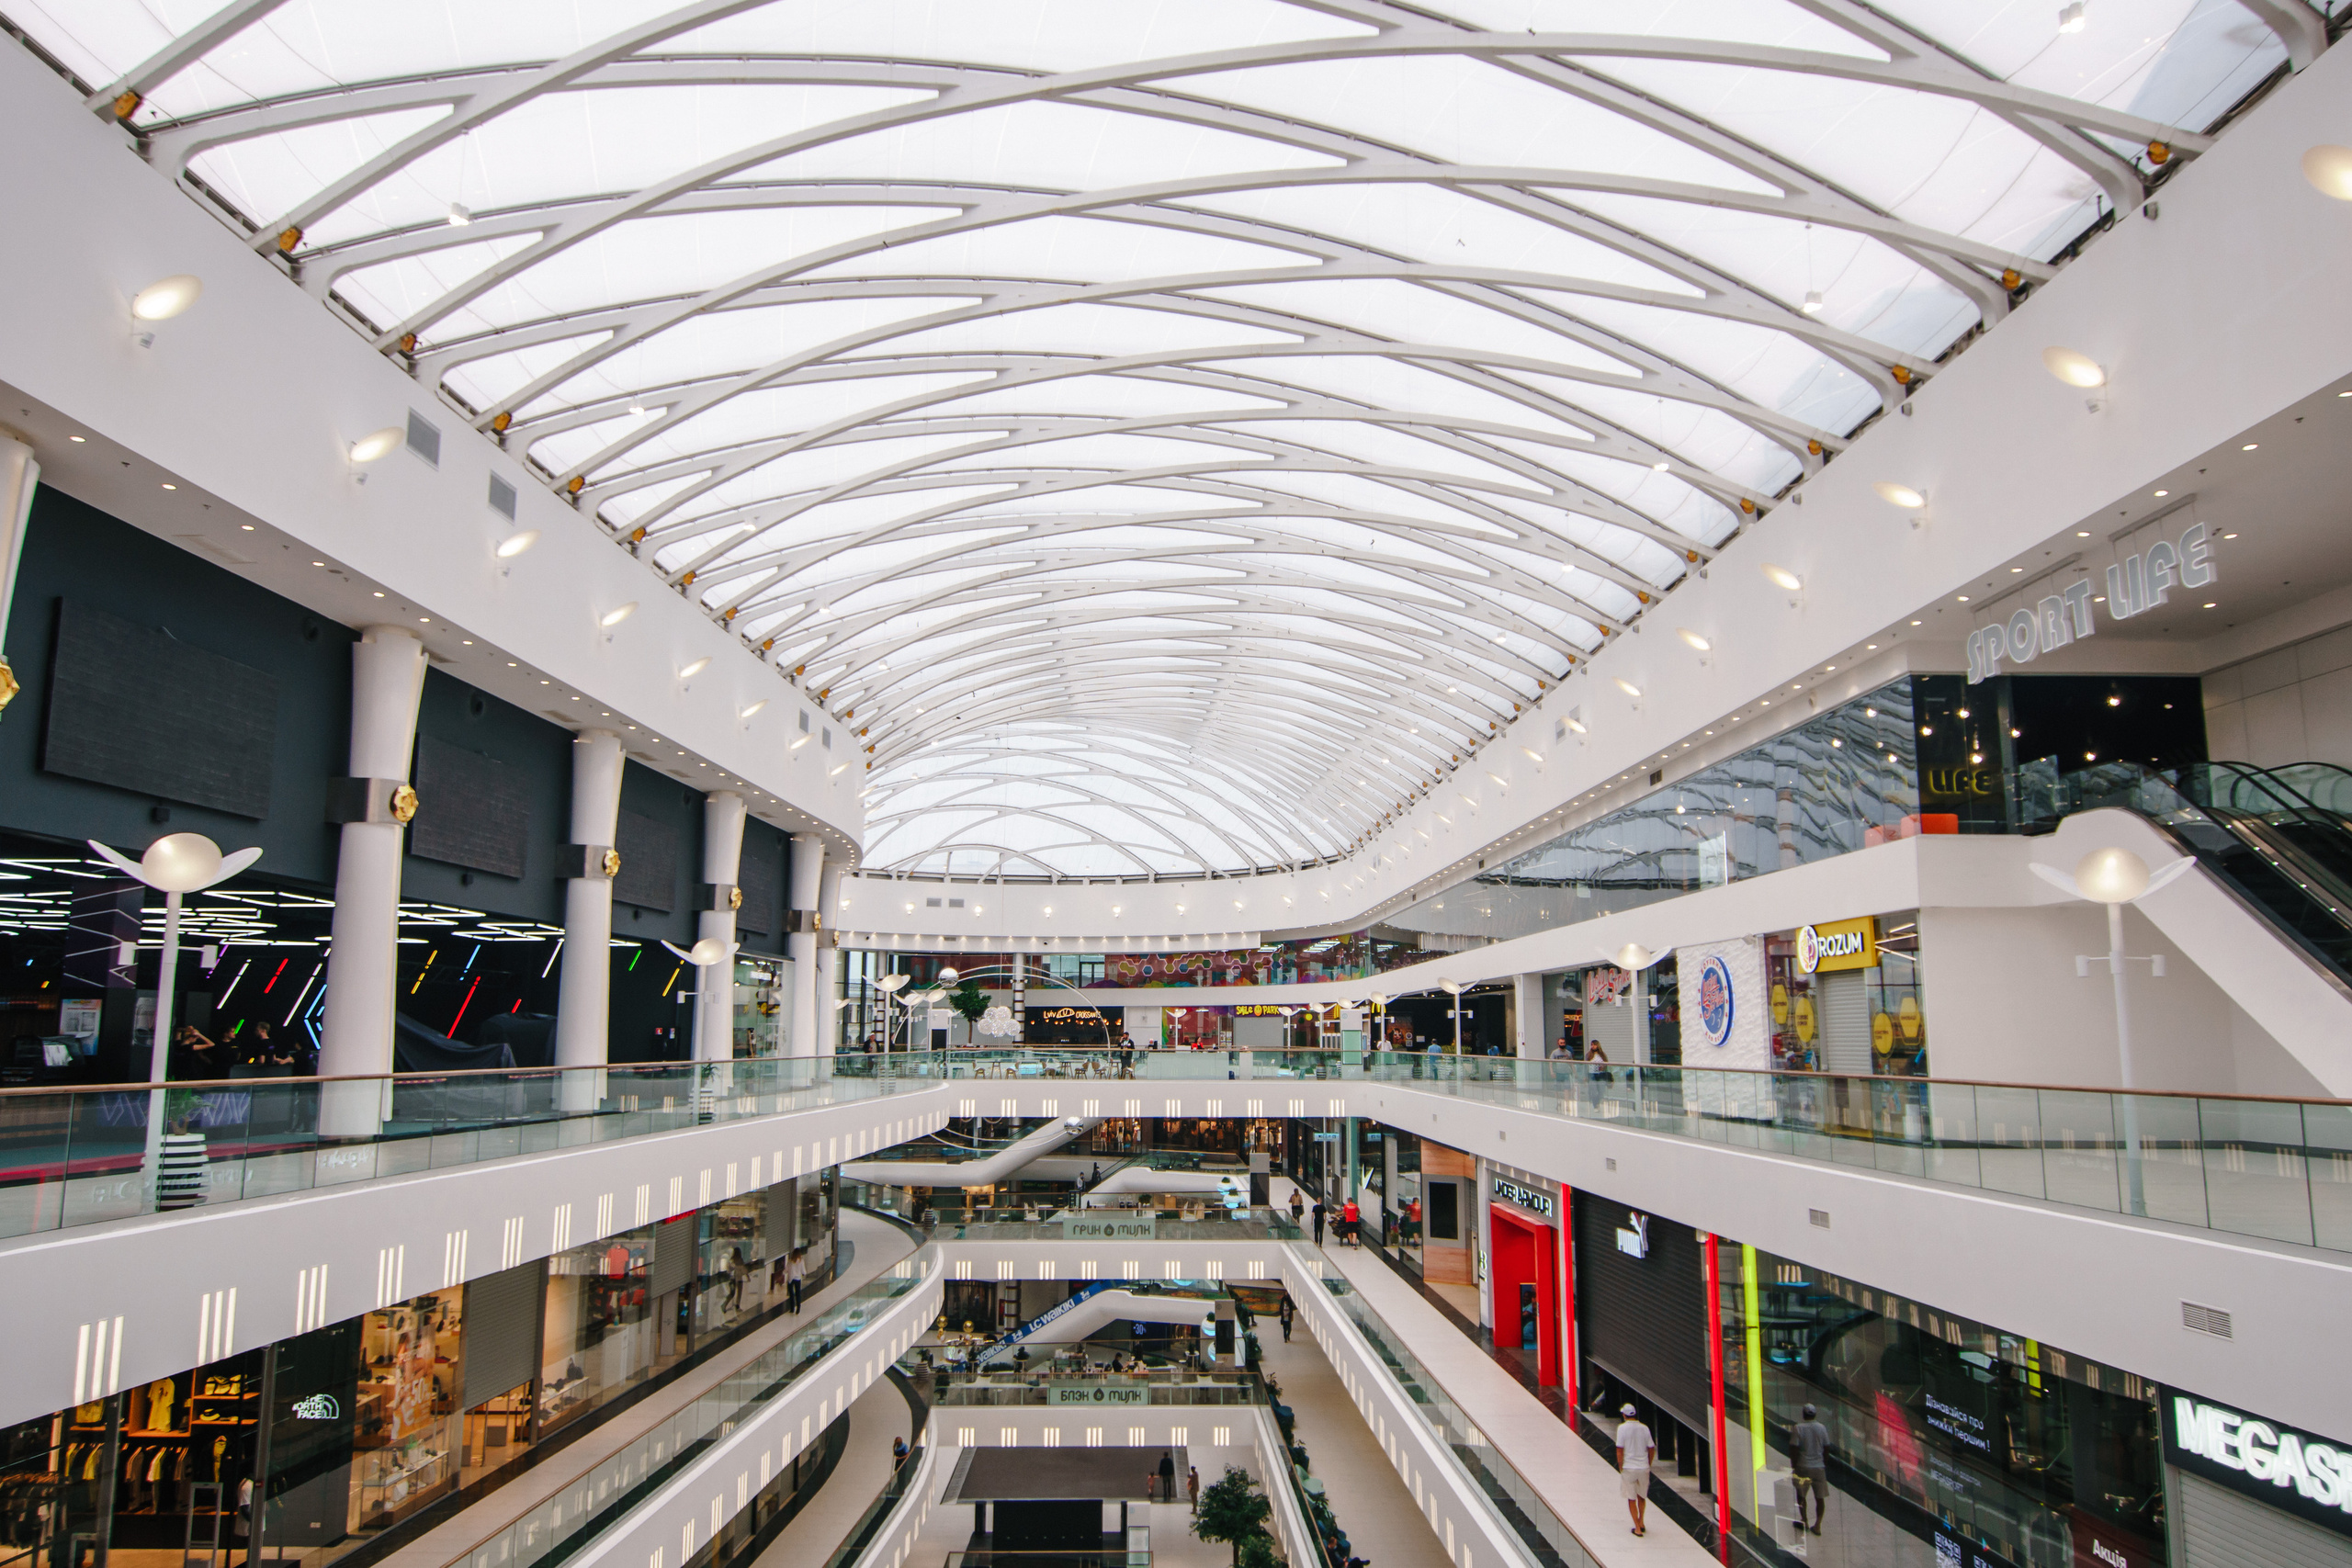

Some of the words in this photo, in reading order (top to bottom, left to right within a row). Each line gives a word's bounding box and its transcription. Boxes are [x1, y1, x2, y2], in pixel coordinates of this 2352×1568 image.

[1967, 579, 2095, 685] SPORT
[2107, 522, 2217, 621] LIFE
[1928, 768, 1992, 795] LIFE
[1817, 931, 1864, 958] ROZUM
[1588, 967, 1609, 1005] Lucky
[1043, 1010, 1057, 1019] Lviv
[1262, 1005, 1280, 1016] PARK
[1072, 1224, 1102, 1235] ГРИН
[1616, 1227, 1645, 1258] PUMA
[1029, 1318, 1043, 1333] LC
[1060, 1390, 1090, 1402] БЛЭК
[296, 1409, 322, 1419] FACE
[1969, 1416, 1984, 1431] про
[1927, 1415, 1953, 1435] знижки
[1954, 1427, 1986, 1450] першим
[2092, 1539, 2128, 1568] Акція
